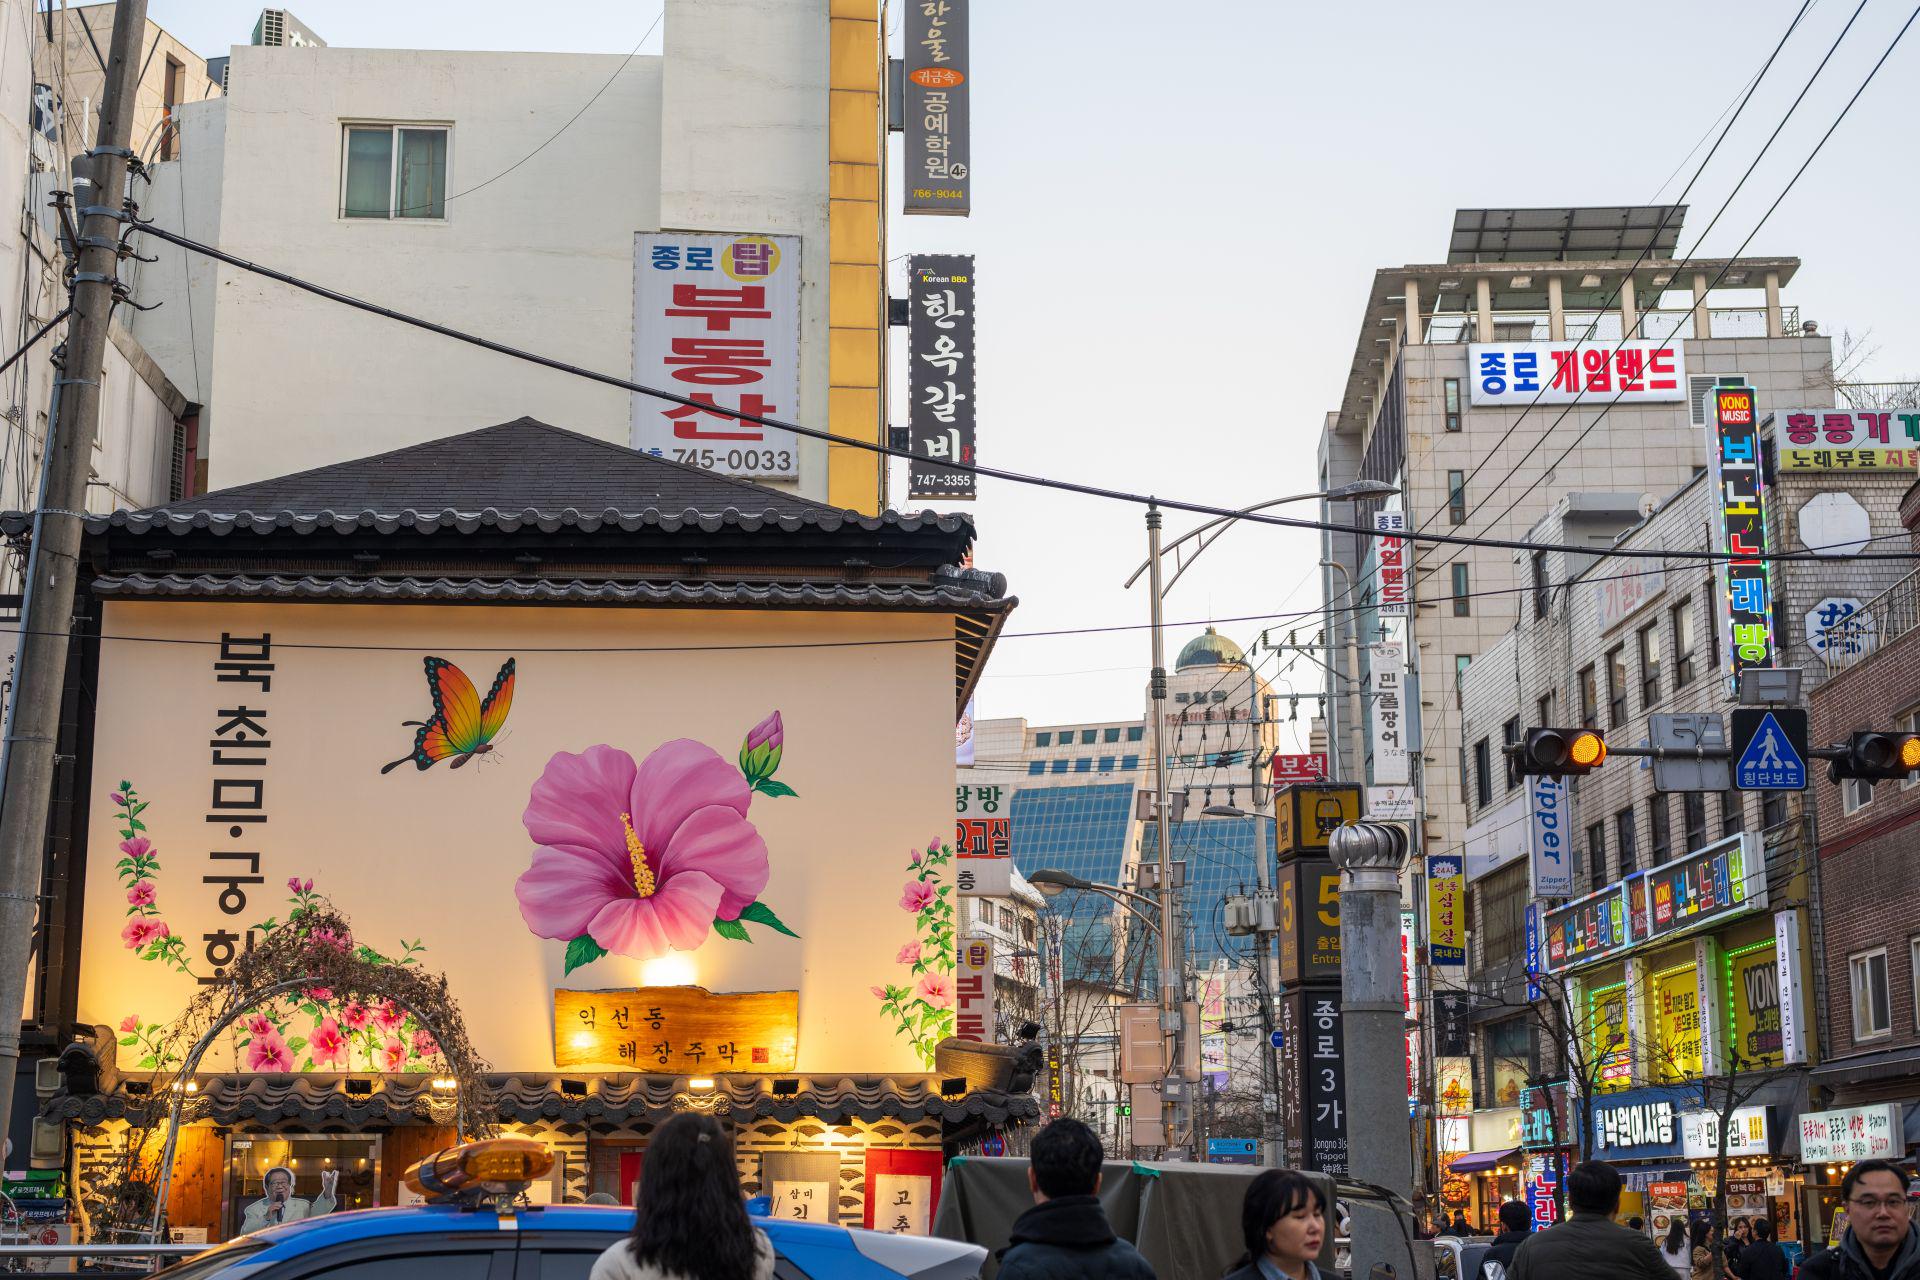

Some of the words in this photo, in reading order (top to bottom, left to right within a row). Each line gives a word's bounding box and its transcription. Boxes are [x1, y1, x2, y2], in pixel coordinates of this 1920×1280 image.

[919, 71, 956, 84] 귀금속
[924, 92, 950, 179] 공예학원
[951, 165, 966, 177] 4F
[913, 188, 962, 199] 766-9044
[652, 245, 713, 271] 종로
[732, 243, 773, 276] 탑
[923, 275, 949, 283] Korean
[951, 275, 967, 283] BBQ
[661, 284, 776, 441] 부동산
[1480, 352, 1540, 395] 종로
[1551, 348, 1678, 393] 게임랜드
[921, 289, 966, 464] 한옥갈비
[1720, 396, 1749, 410] VONO
[1722, 410, 1750, 422] MUSIC
[672, 448, 791, 471] 745-0033
[1792, 450, 1876, 467] 노래무료
[917, 474, 971, 486] 747-3355
[1280, 756, 1322, 775] 보석
[1744, 772, 1798, 785] 횡단보도
[1536, 776, 1562, 865] ipper
[1541, 876, 1567, 884] Zipper
[1283, 880, 1293, 931] 5
[1438, 893, 1456, 944] 삼겹살
[970, 946, 986, 966] 탑
[1434, 949, 1461, 958] 국내산
[579, 1006, 665, 1030] 익선동
[618, 1041, 739, 1064] 해장주막
[1283, 1002, 1295, 1128] 종로3가
[1313, 1000, 1343, 1129] 종로3가
[1706, 1118, 1741, 1148] 만집
[1314, 1138, 1335, 1150] Jongno
